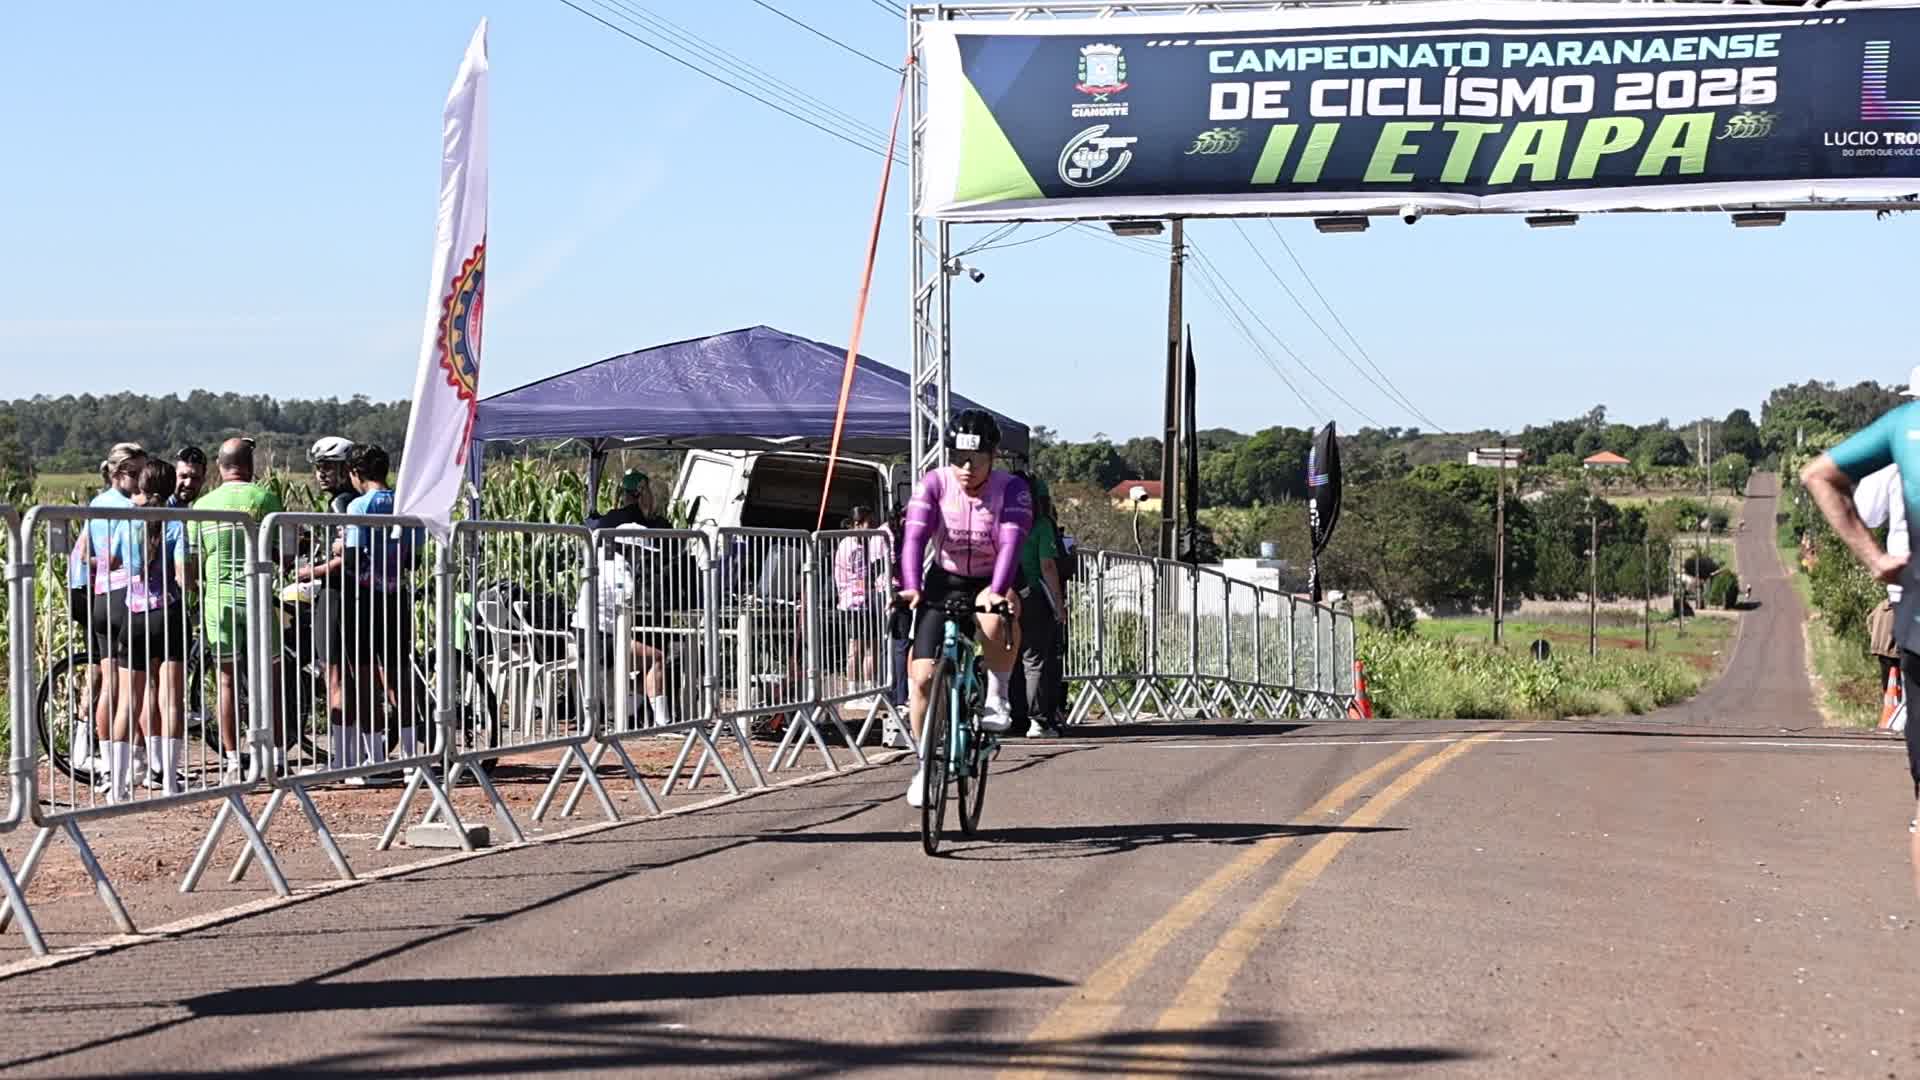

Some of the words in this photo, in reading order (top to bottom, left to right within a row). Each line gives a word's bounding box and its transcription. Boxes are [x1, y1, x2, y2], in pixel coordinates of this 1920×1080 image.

[1209, 41, 1490, 74] CAMPEONATO
[1502, 33, 1782, 68] PARANAENSE
[1209, 80, 1291, 121] DE
[1309, 66, 1596, 118] CICLÍSMO
[1071, 107, 1129, 118] CIANORTE
[1250, 123, 1341, 185] II
[1362, 112, 1716, 185] ETAPA
[1824, 130, 1879, 146] LUCIO
[1882, 132, 1920, 145] TRO
[1842, 149, 1855, 157] DO
[1876, 149, 1893, 157] QUE
[1894, 147, 1914, 156] VOCÊ
